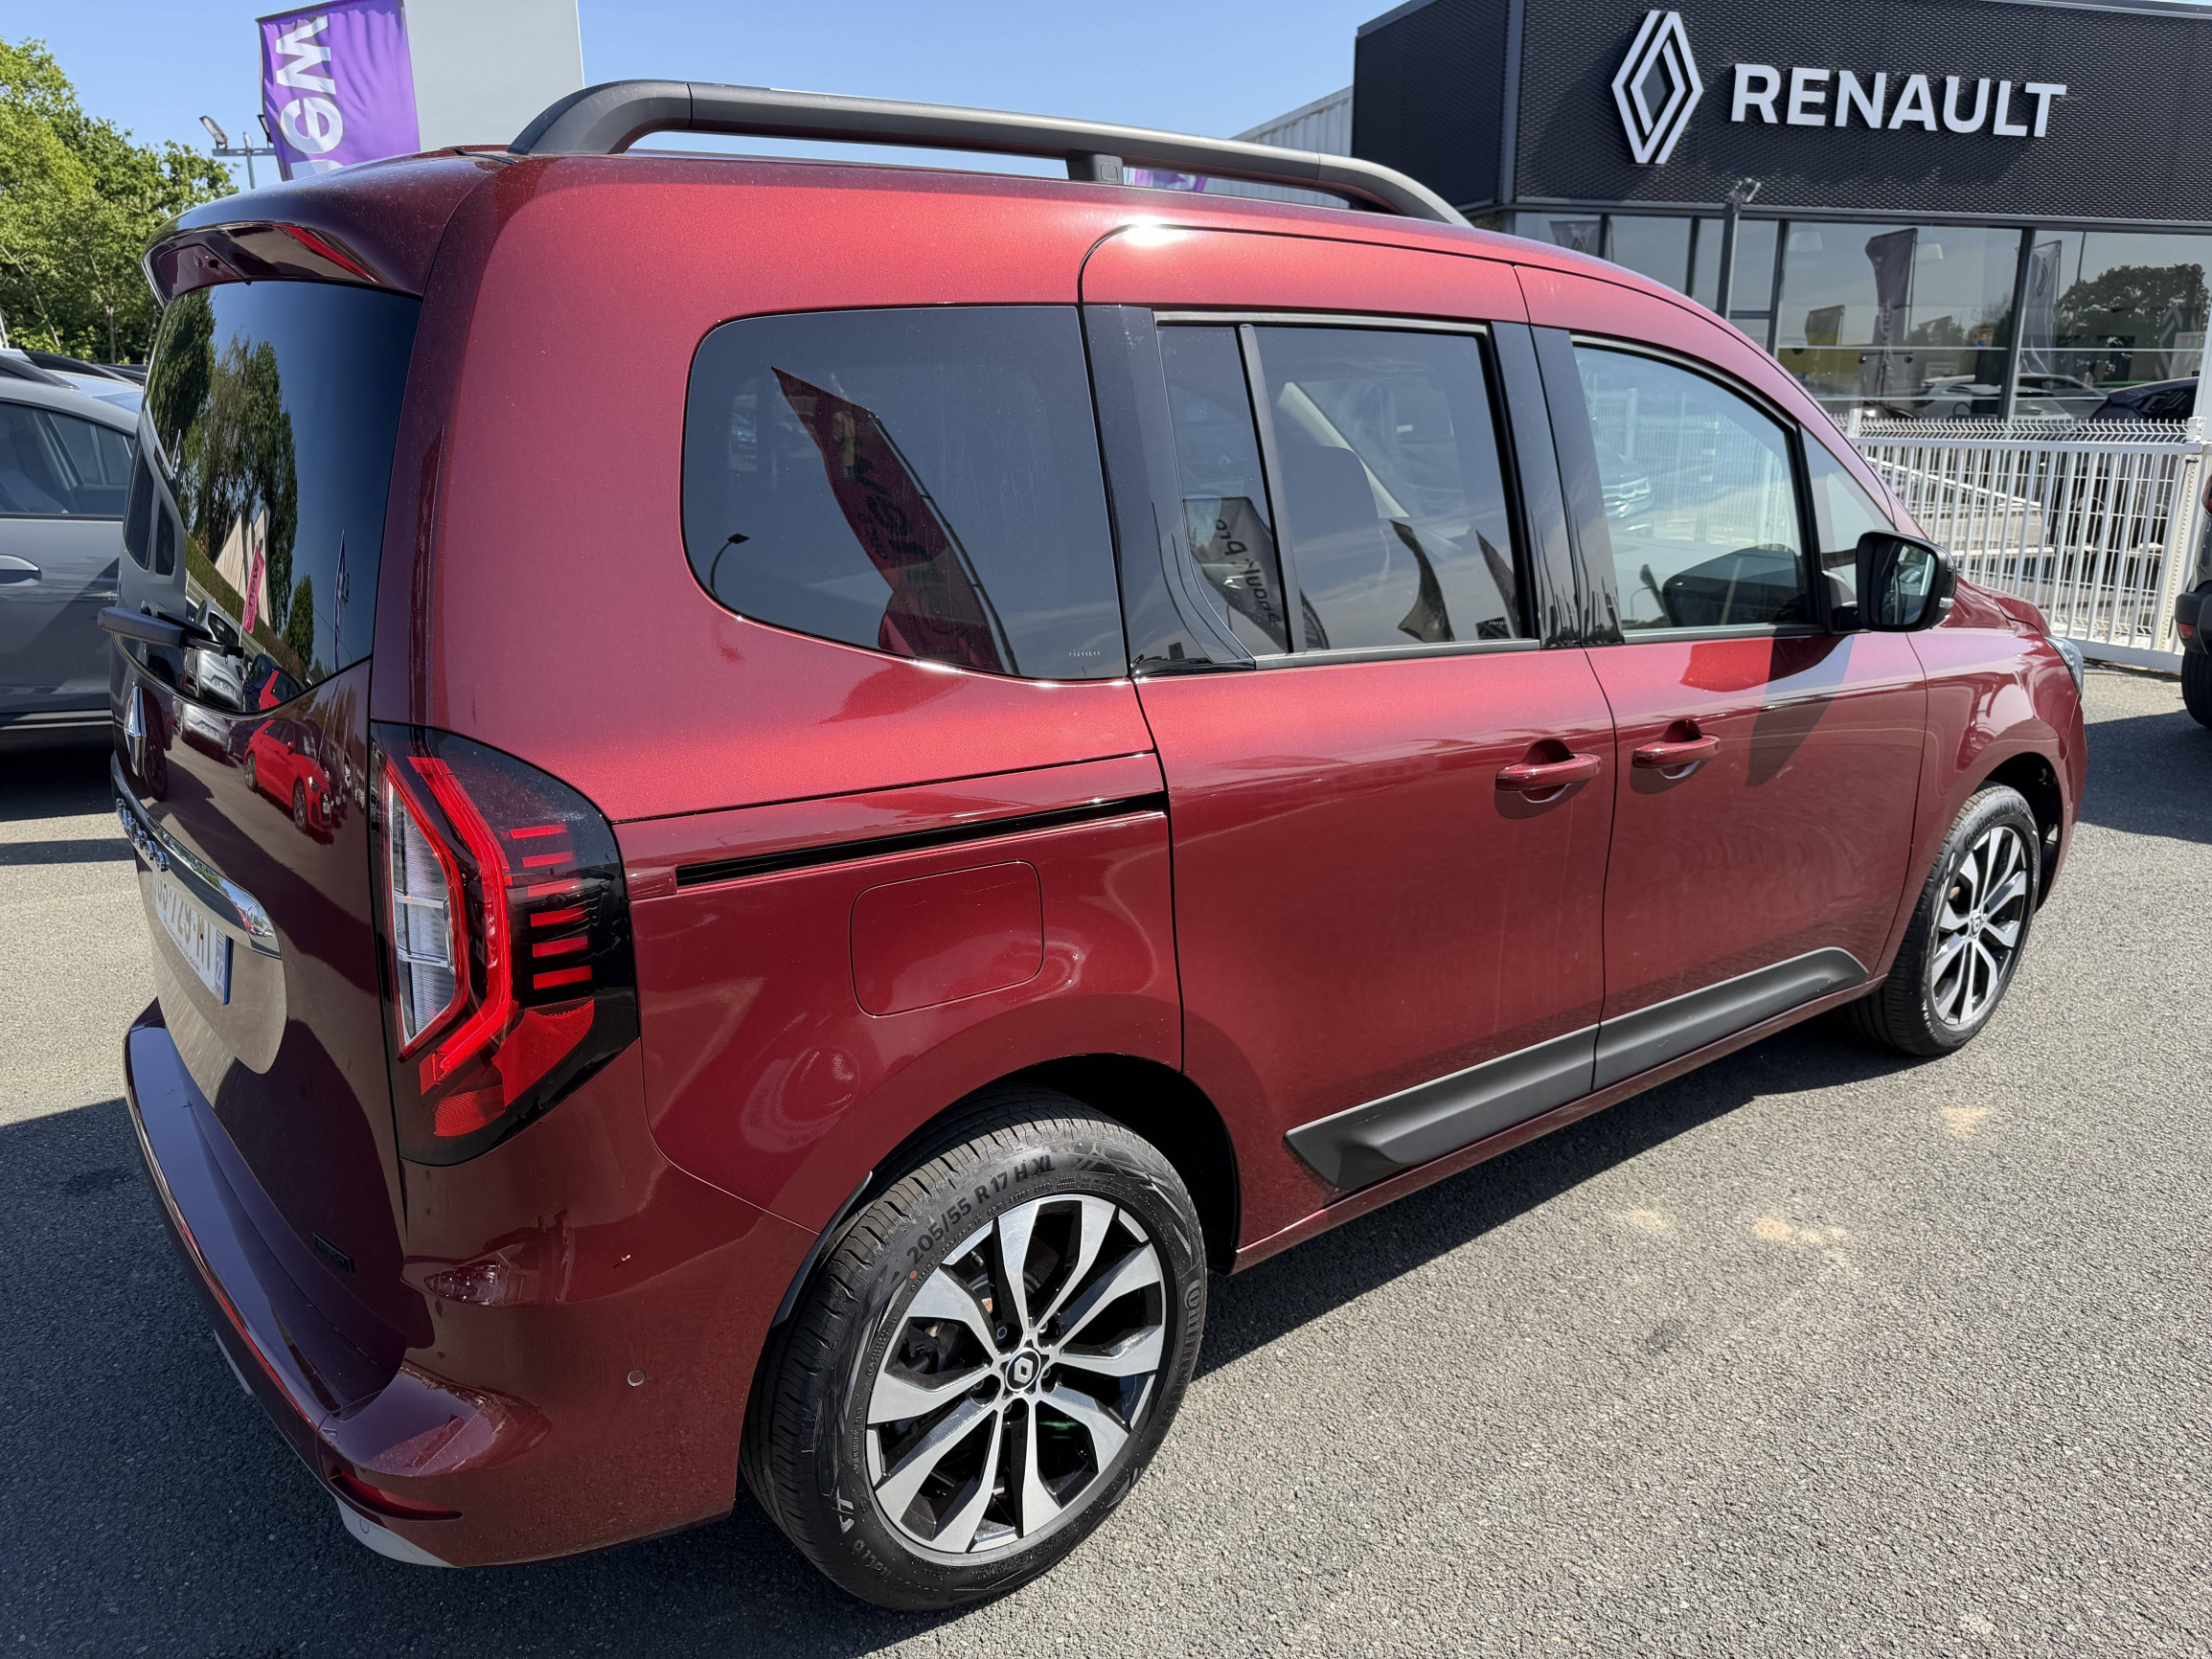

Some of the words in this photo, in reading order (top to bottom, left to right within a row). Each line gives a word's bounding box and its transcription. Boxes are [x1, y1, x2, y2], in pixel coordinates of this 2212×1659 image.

[1730, 62, 2068, 138] RENAULT
[906, 1196, 971, 1265] 205/55
[974, 1185, 991, 1205] R
[991, 1171, 1008, 1193] 17
[1014, 1162, 1029, 1183] H
[1034, 1154, 1057, 1176] XL
